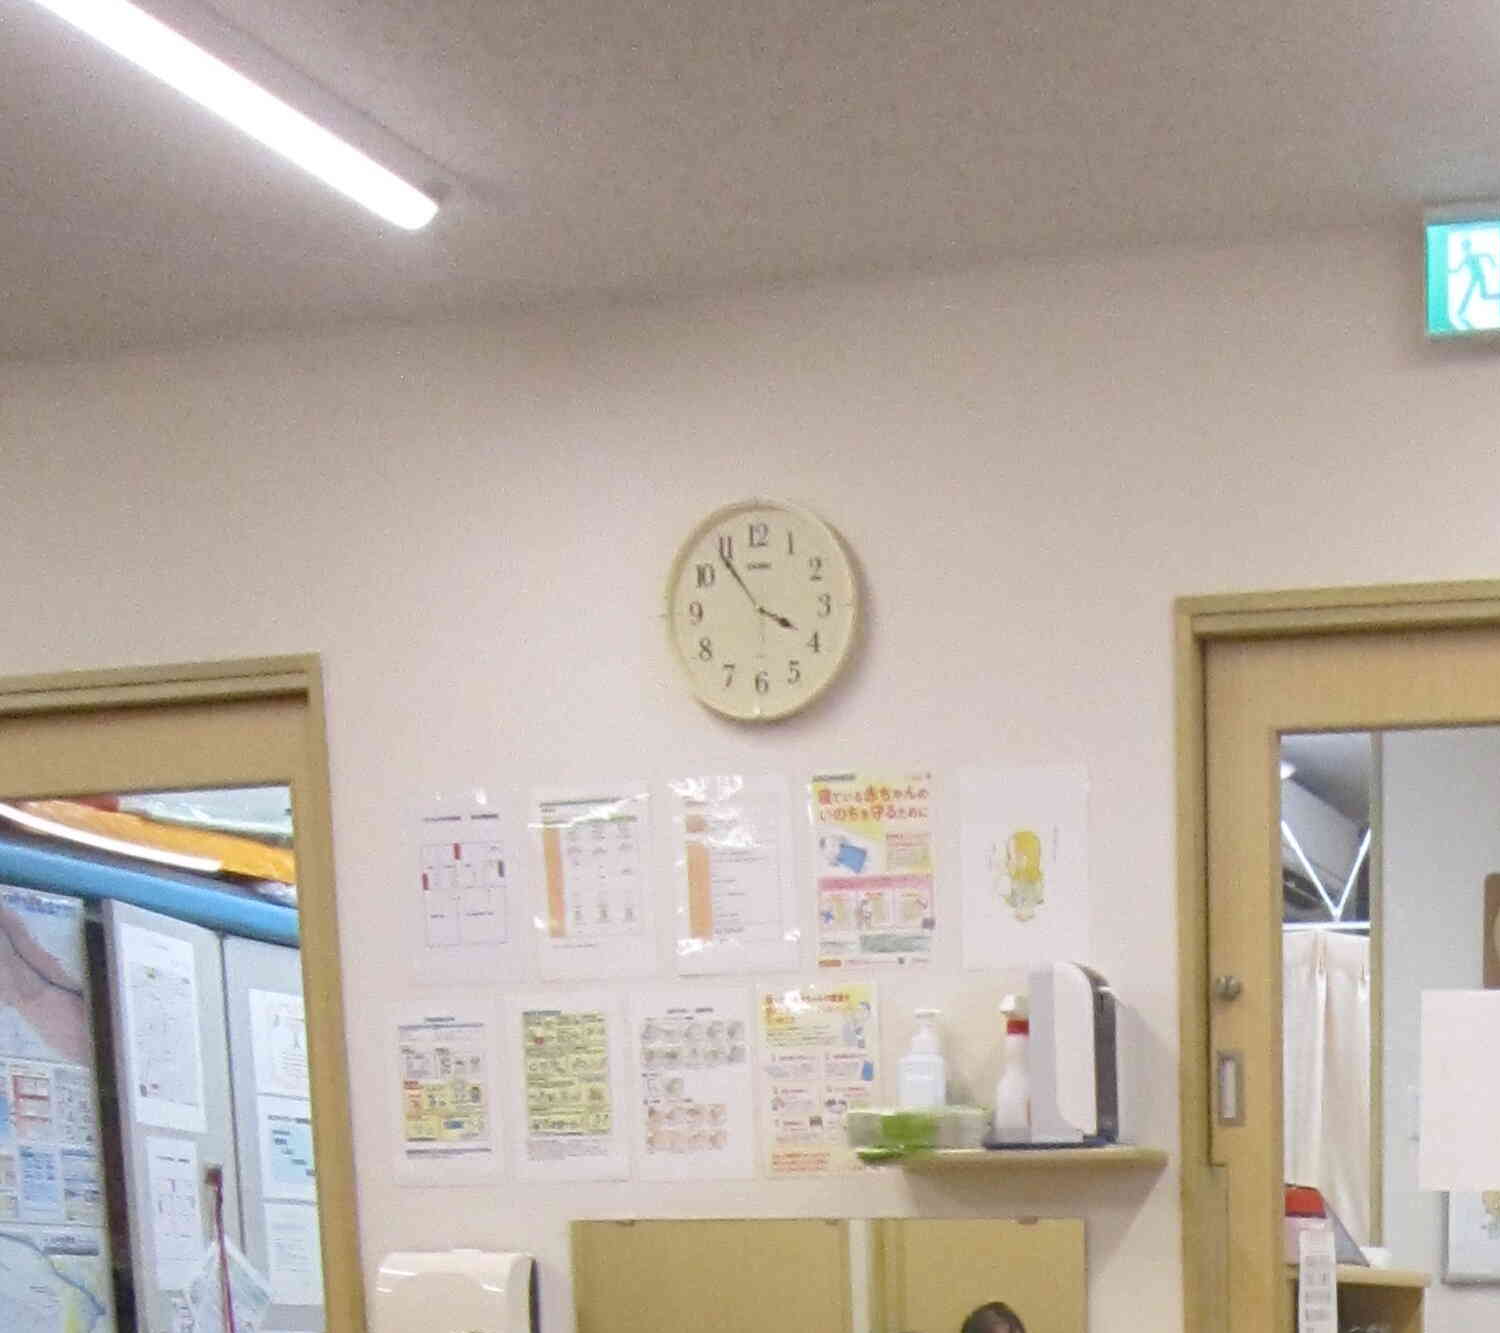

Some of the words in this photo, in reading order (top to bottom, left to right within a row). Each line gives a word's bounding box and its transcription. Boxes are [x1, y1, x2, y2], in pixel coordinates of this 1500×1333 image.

[748, 523, 769, 549] 12
[786, 530, 794, 555] 1
[695, 563, 715, 589] 10
[808, 557, 823, 582] 2
[689, 601, 704, 626] 9
[817, 593, 832, 618] 3
[699, 637, 713, 661] 8
[807, 631, 820, 653] 4
[723, 663, 736, 688] 7
[754, 671, 769, 694] 6
[787, 659, 801, 684] 5
[820, 806, 929, 822] いのちを守るために
